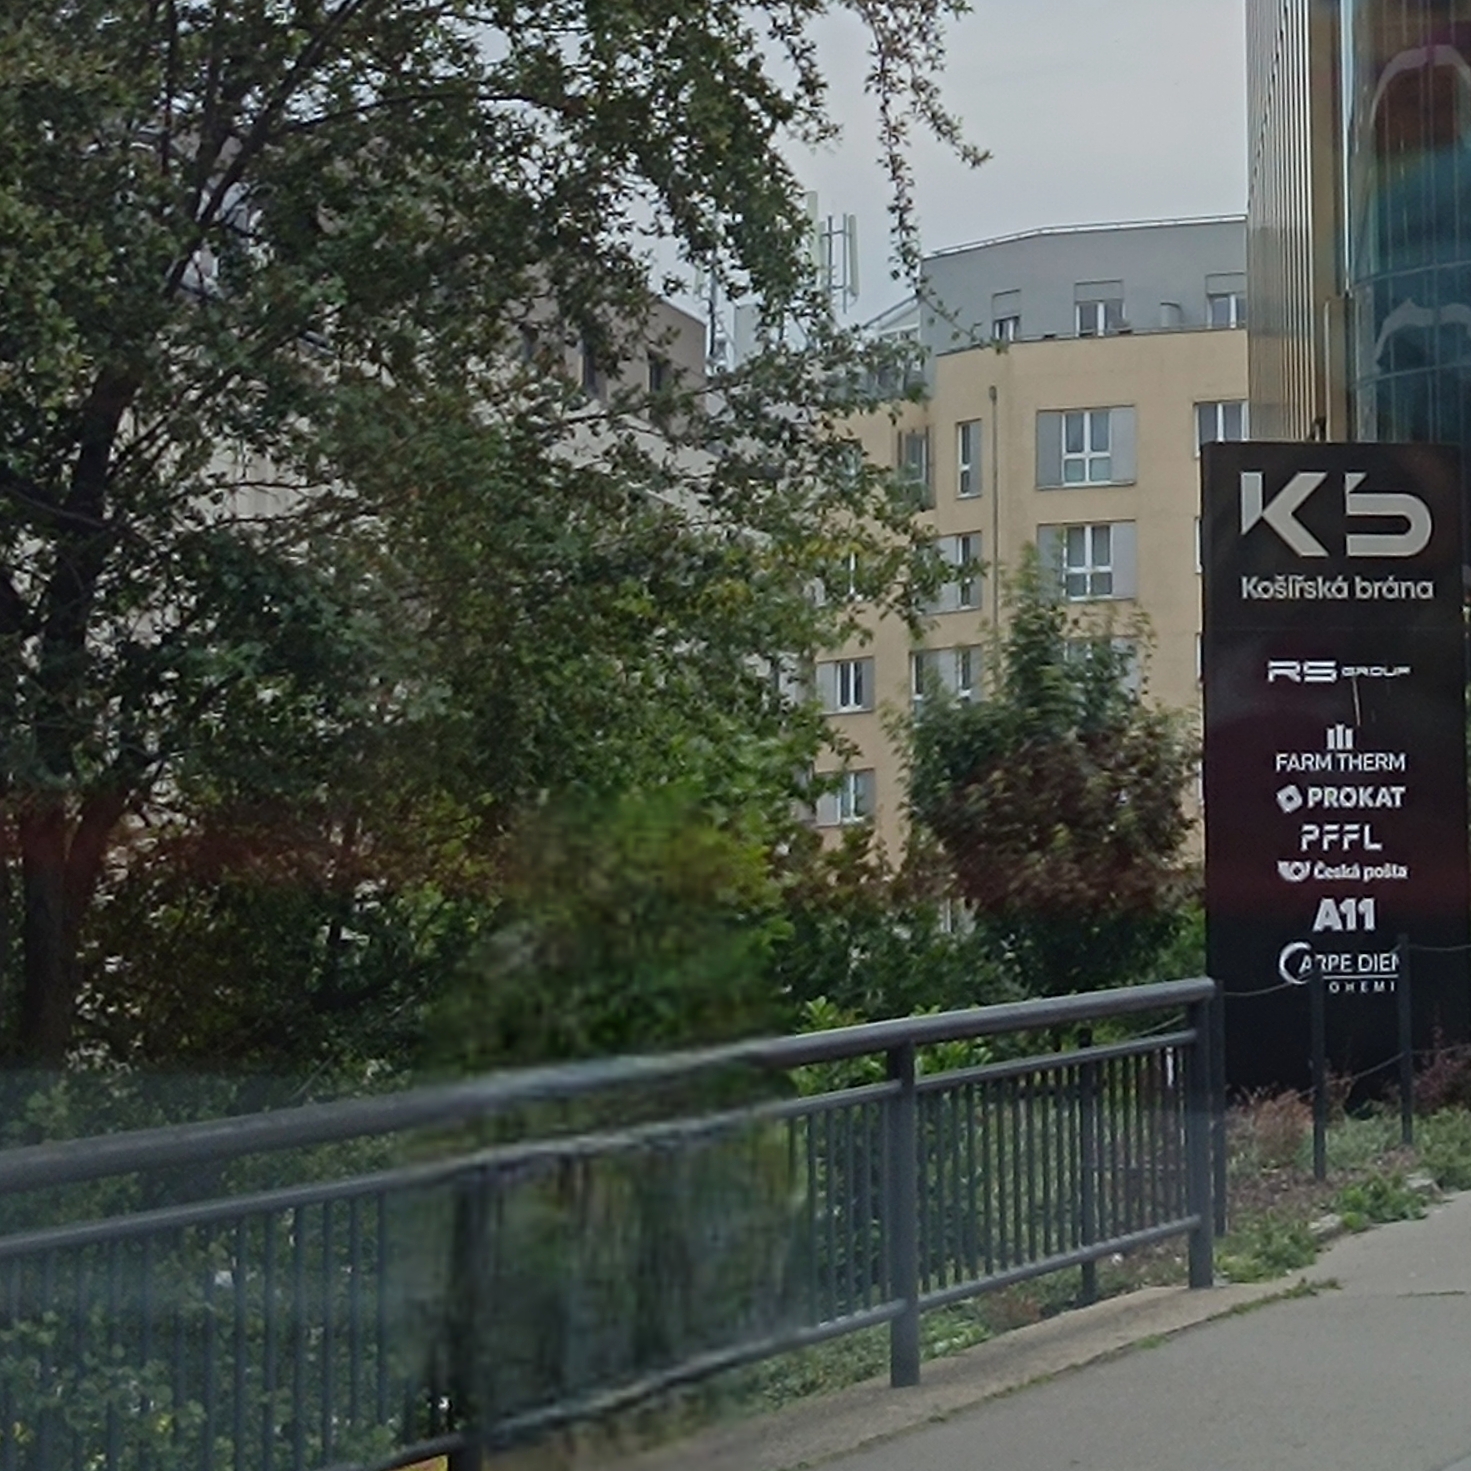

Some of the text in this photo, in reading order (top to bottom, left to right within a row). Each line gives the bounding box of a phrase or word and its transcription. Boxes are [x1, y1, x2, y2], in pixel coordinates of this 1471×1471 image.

[1241, 575, 1434, 599] Košířská brána
[1268, 661, 1411, 682] RS GROUP
[1275, 753, 1406, 772] FARM THERM
[1307, 786, 1406, 808] PROKAT
[1301, 823, 1383, 852] PFFL
[1313, 861, 1408, 882] Česká pošta
[1312, 897, 1376, 931] A11
